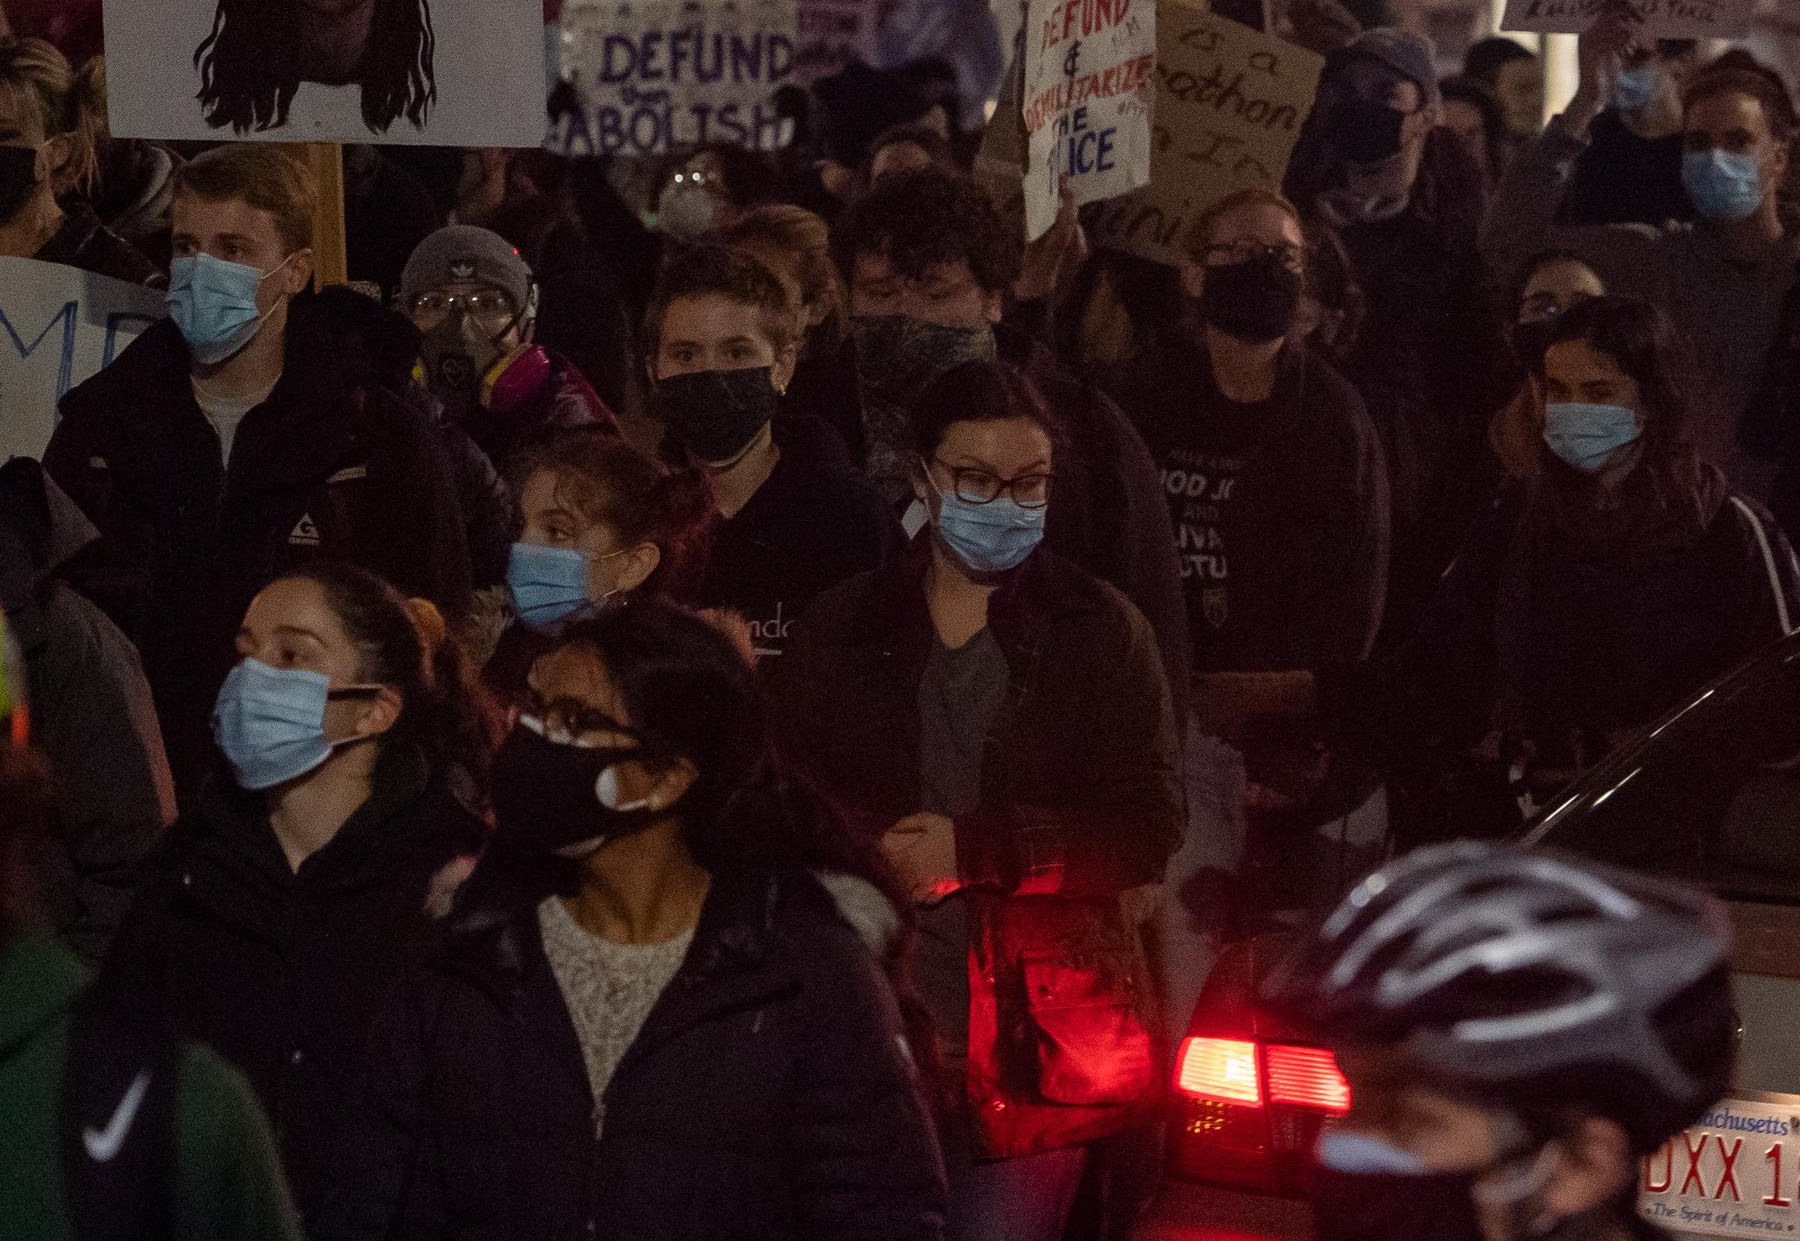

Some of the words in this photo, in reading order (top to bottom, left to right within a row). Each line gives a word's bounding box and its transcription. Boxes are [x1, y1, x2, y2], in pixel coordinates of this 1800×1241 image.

[600, 29, 797, 84] DEFUND
[1065, 125, 1118, 177] ICE
[1701, 1107, 1789, 1136] achusetts
[1762, 1143, 1800, 1208] 1
[1652, 1202, 1677, 1217] The
[1681, 1205, 1713, 1223] Spirit
[1730, 1214, 1784, 1232] America
